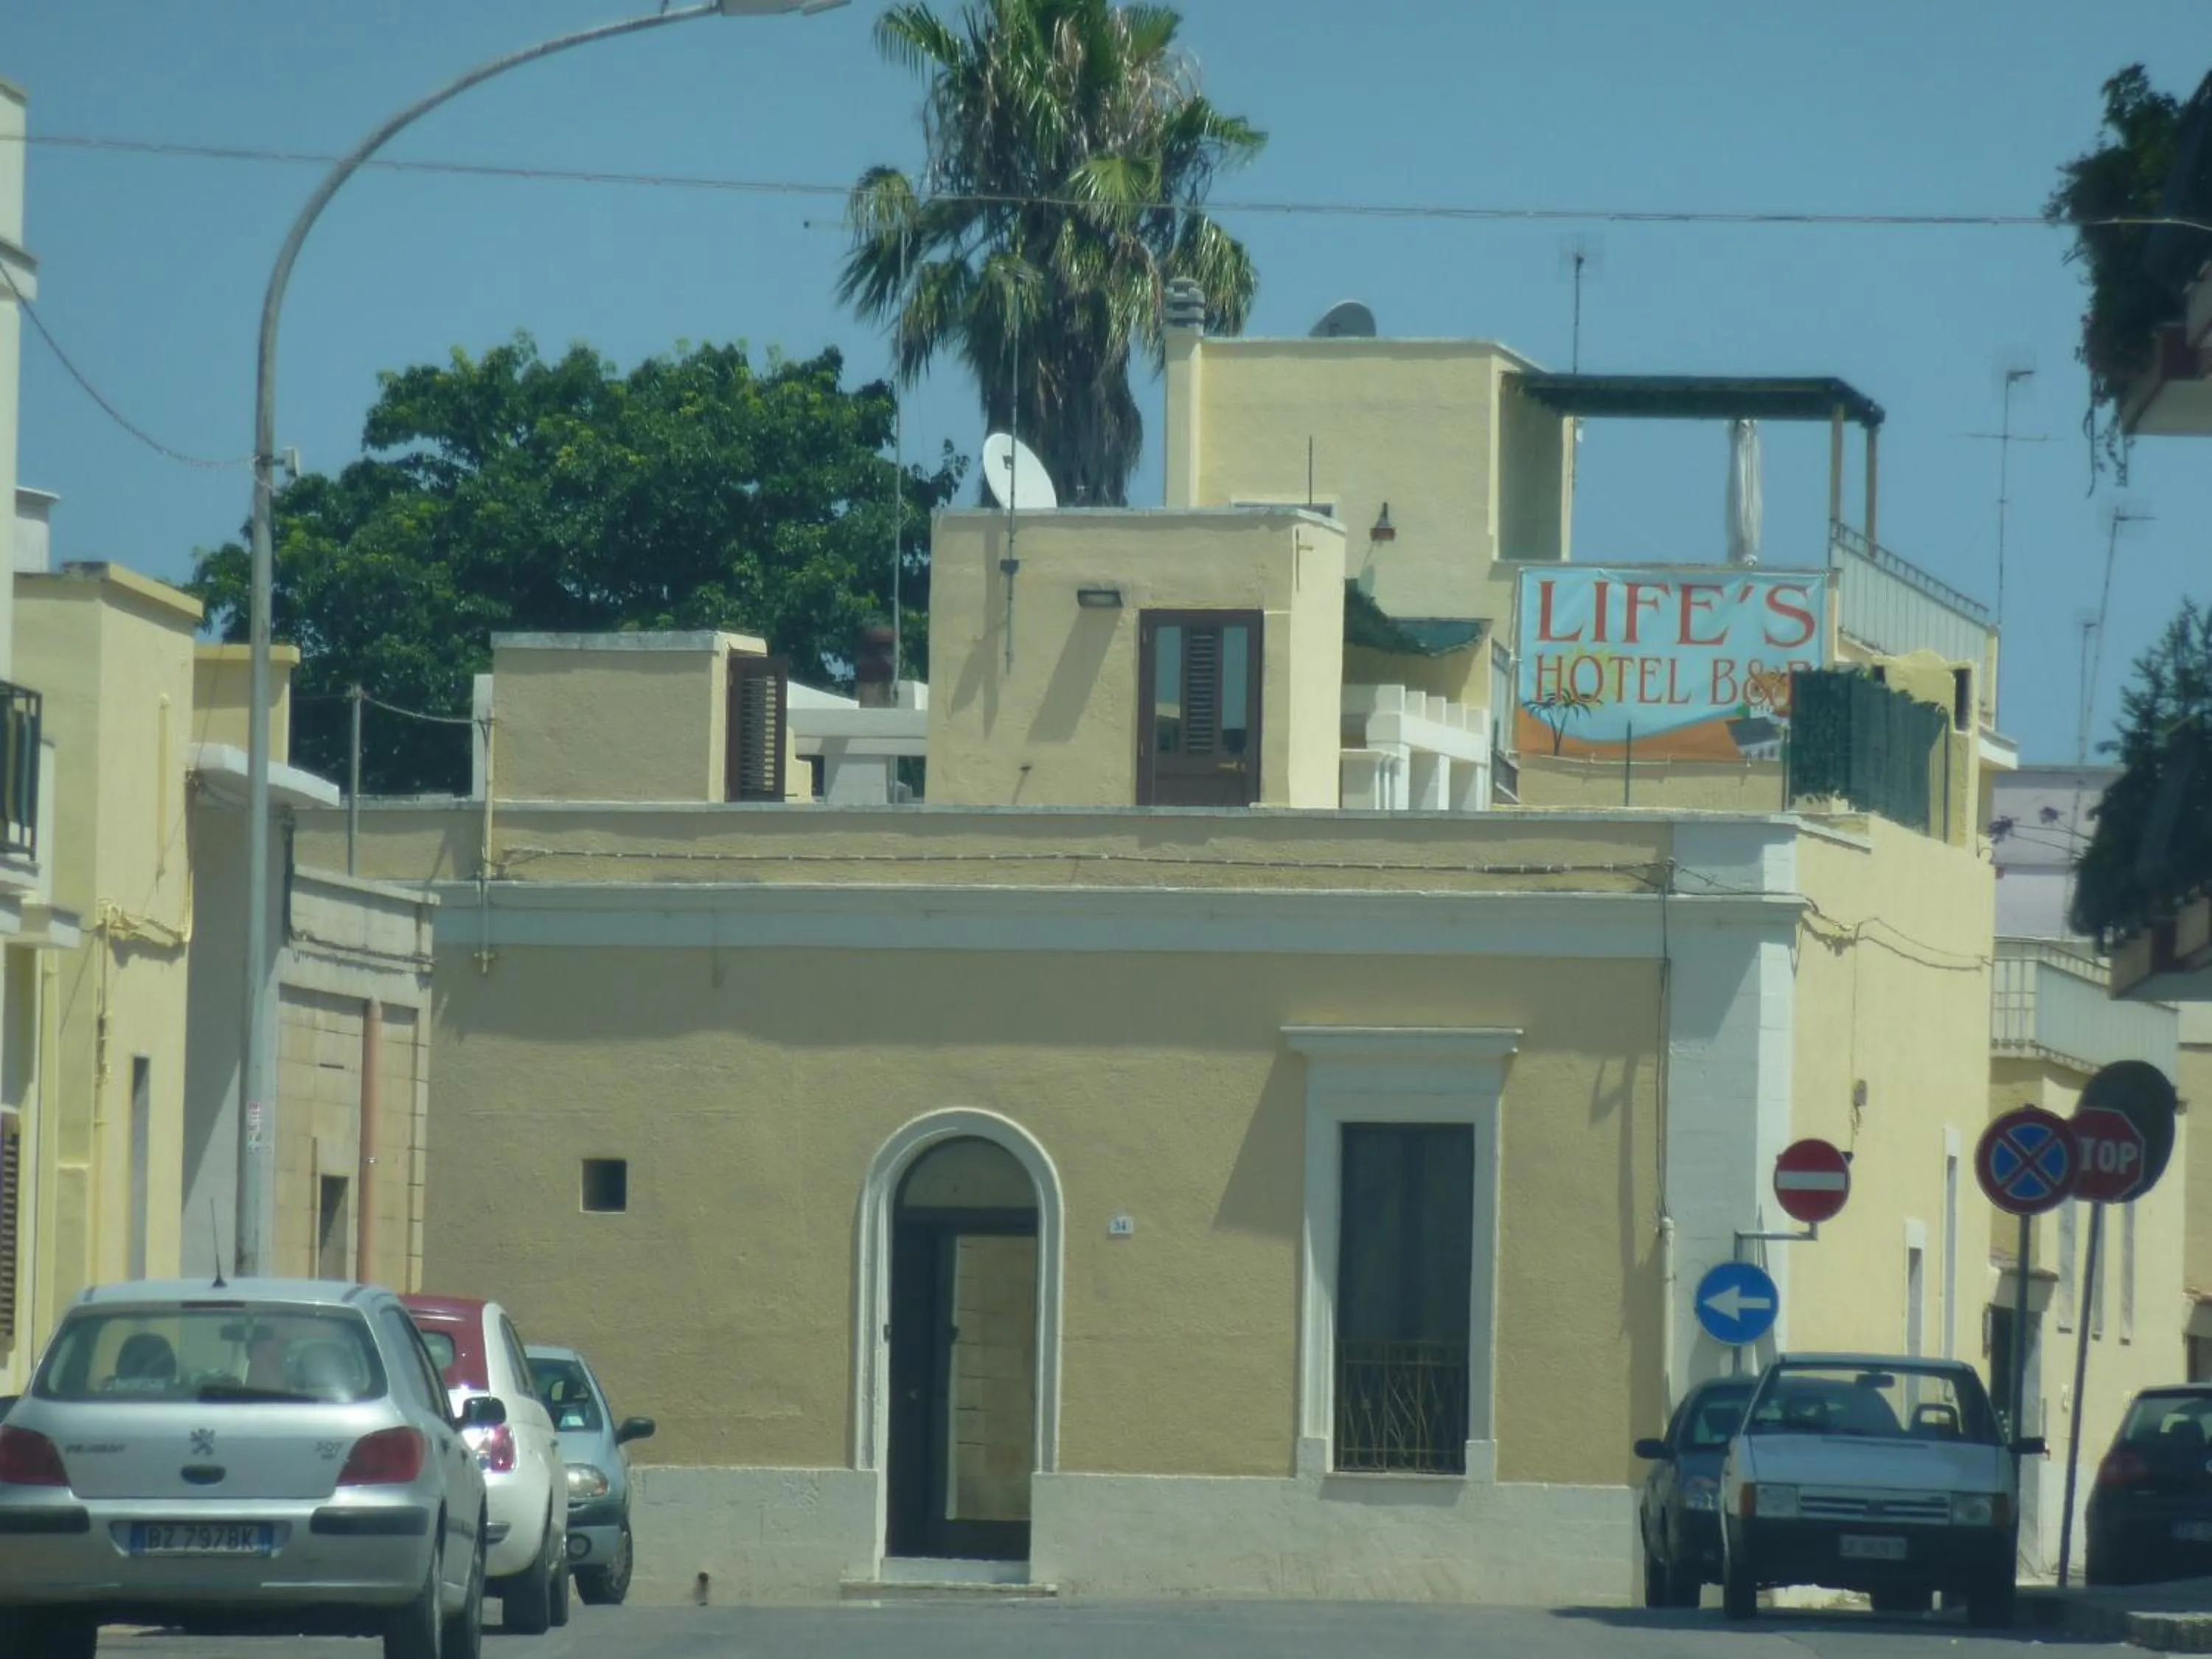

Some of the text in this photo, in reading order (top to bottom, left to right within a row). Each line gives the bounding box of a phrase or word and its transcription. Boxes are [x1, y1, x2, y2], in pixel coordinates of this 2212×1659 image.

[1537, 581, 1815, 647] LIFE'S
[1534, 653, 1691, 704] HOTEL
[2079, 1137, 2138, 1175] TOP
